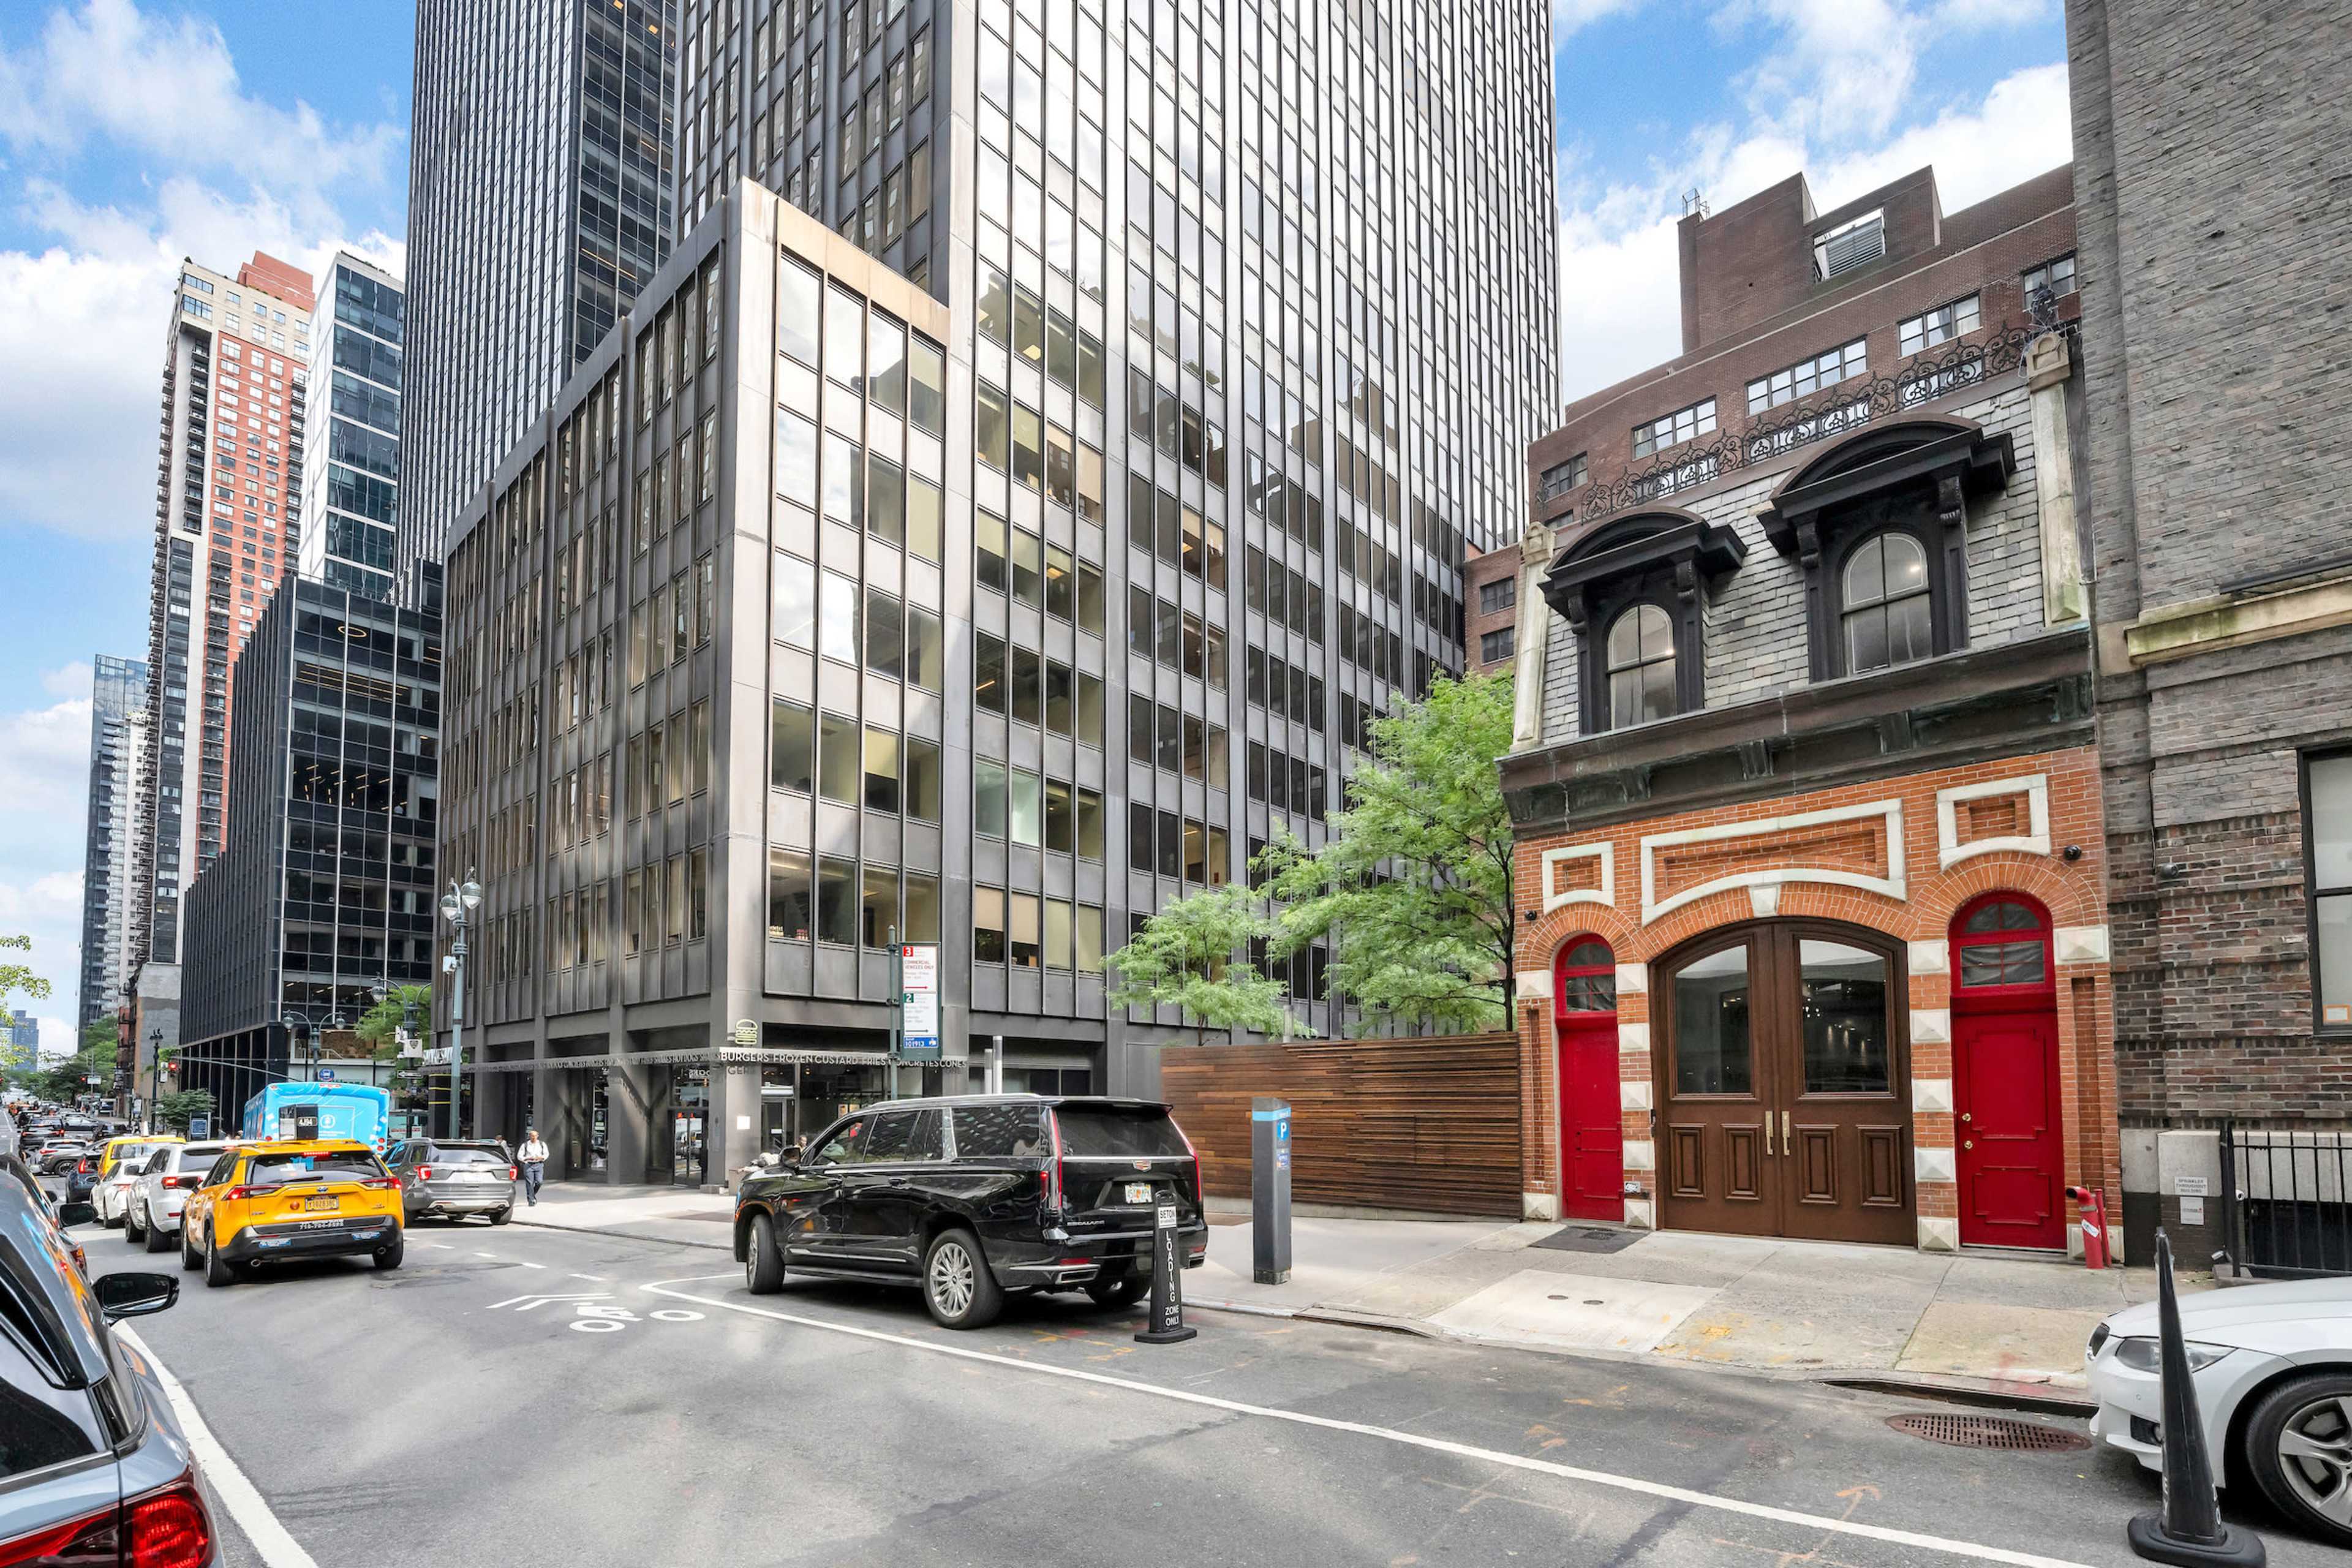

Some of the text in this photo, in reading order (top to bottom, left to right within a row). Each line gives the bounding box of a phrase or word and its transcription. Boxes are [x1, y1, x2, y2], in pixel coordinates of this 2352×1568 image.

[905, 947, 912, 956] 3
[906, 993, 912, 1002] 2
[720, 1052, 769, 1062] BURGERS
[774, 1054, 813, 1063] FROZEN
[815, 1055, 858, 1065] CUSTARD
[862, 1057, 886, 1066] FRIES
[940, 1059, 967, 1068] CONES
[1280, 1121, 1287, 1139] P
[1166, 1230, 1175, 1302] LOADING
[1165, 1305, 1179, 1316] ZONE
[1165, 1316, 1179, 1327] ONLY
